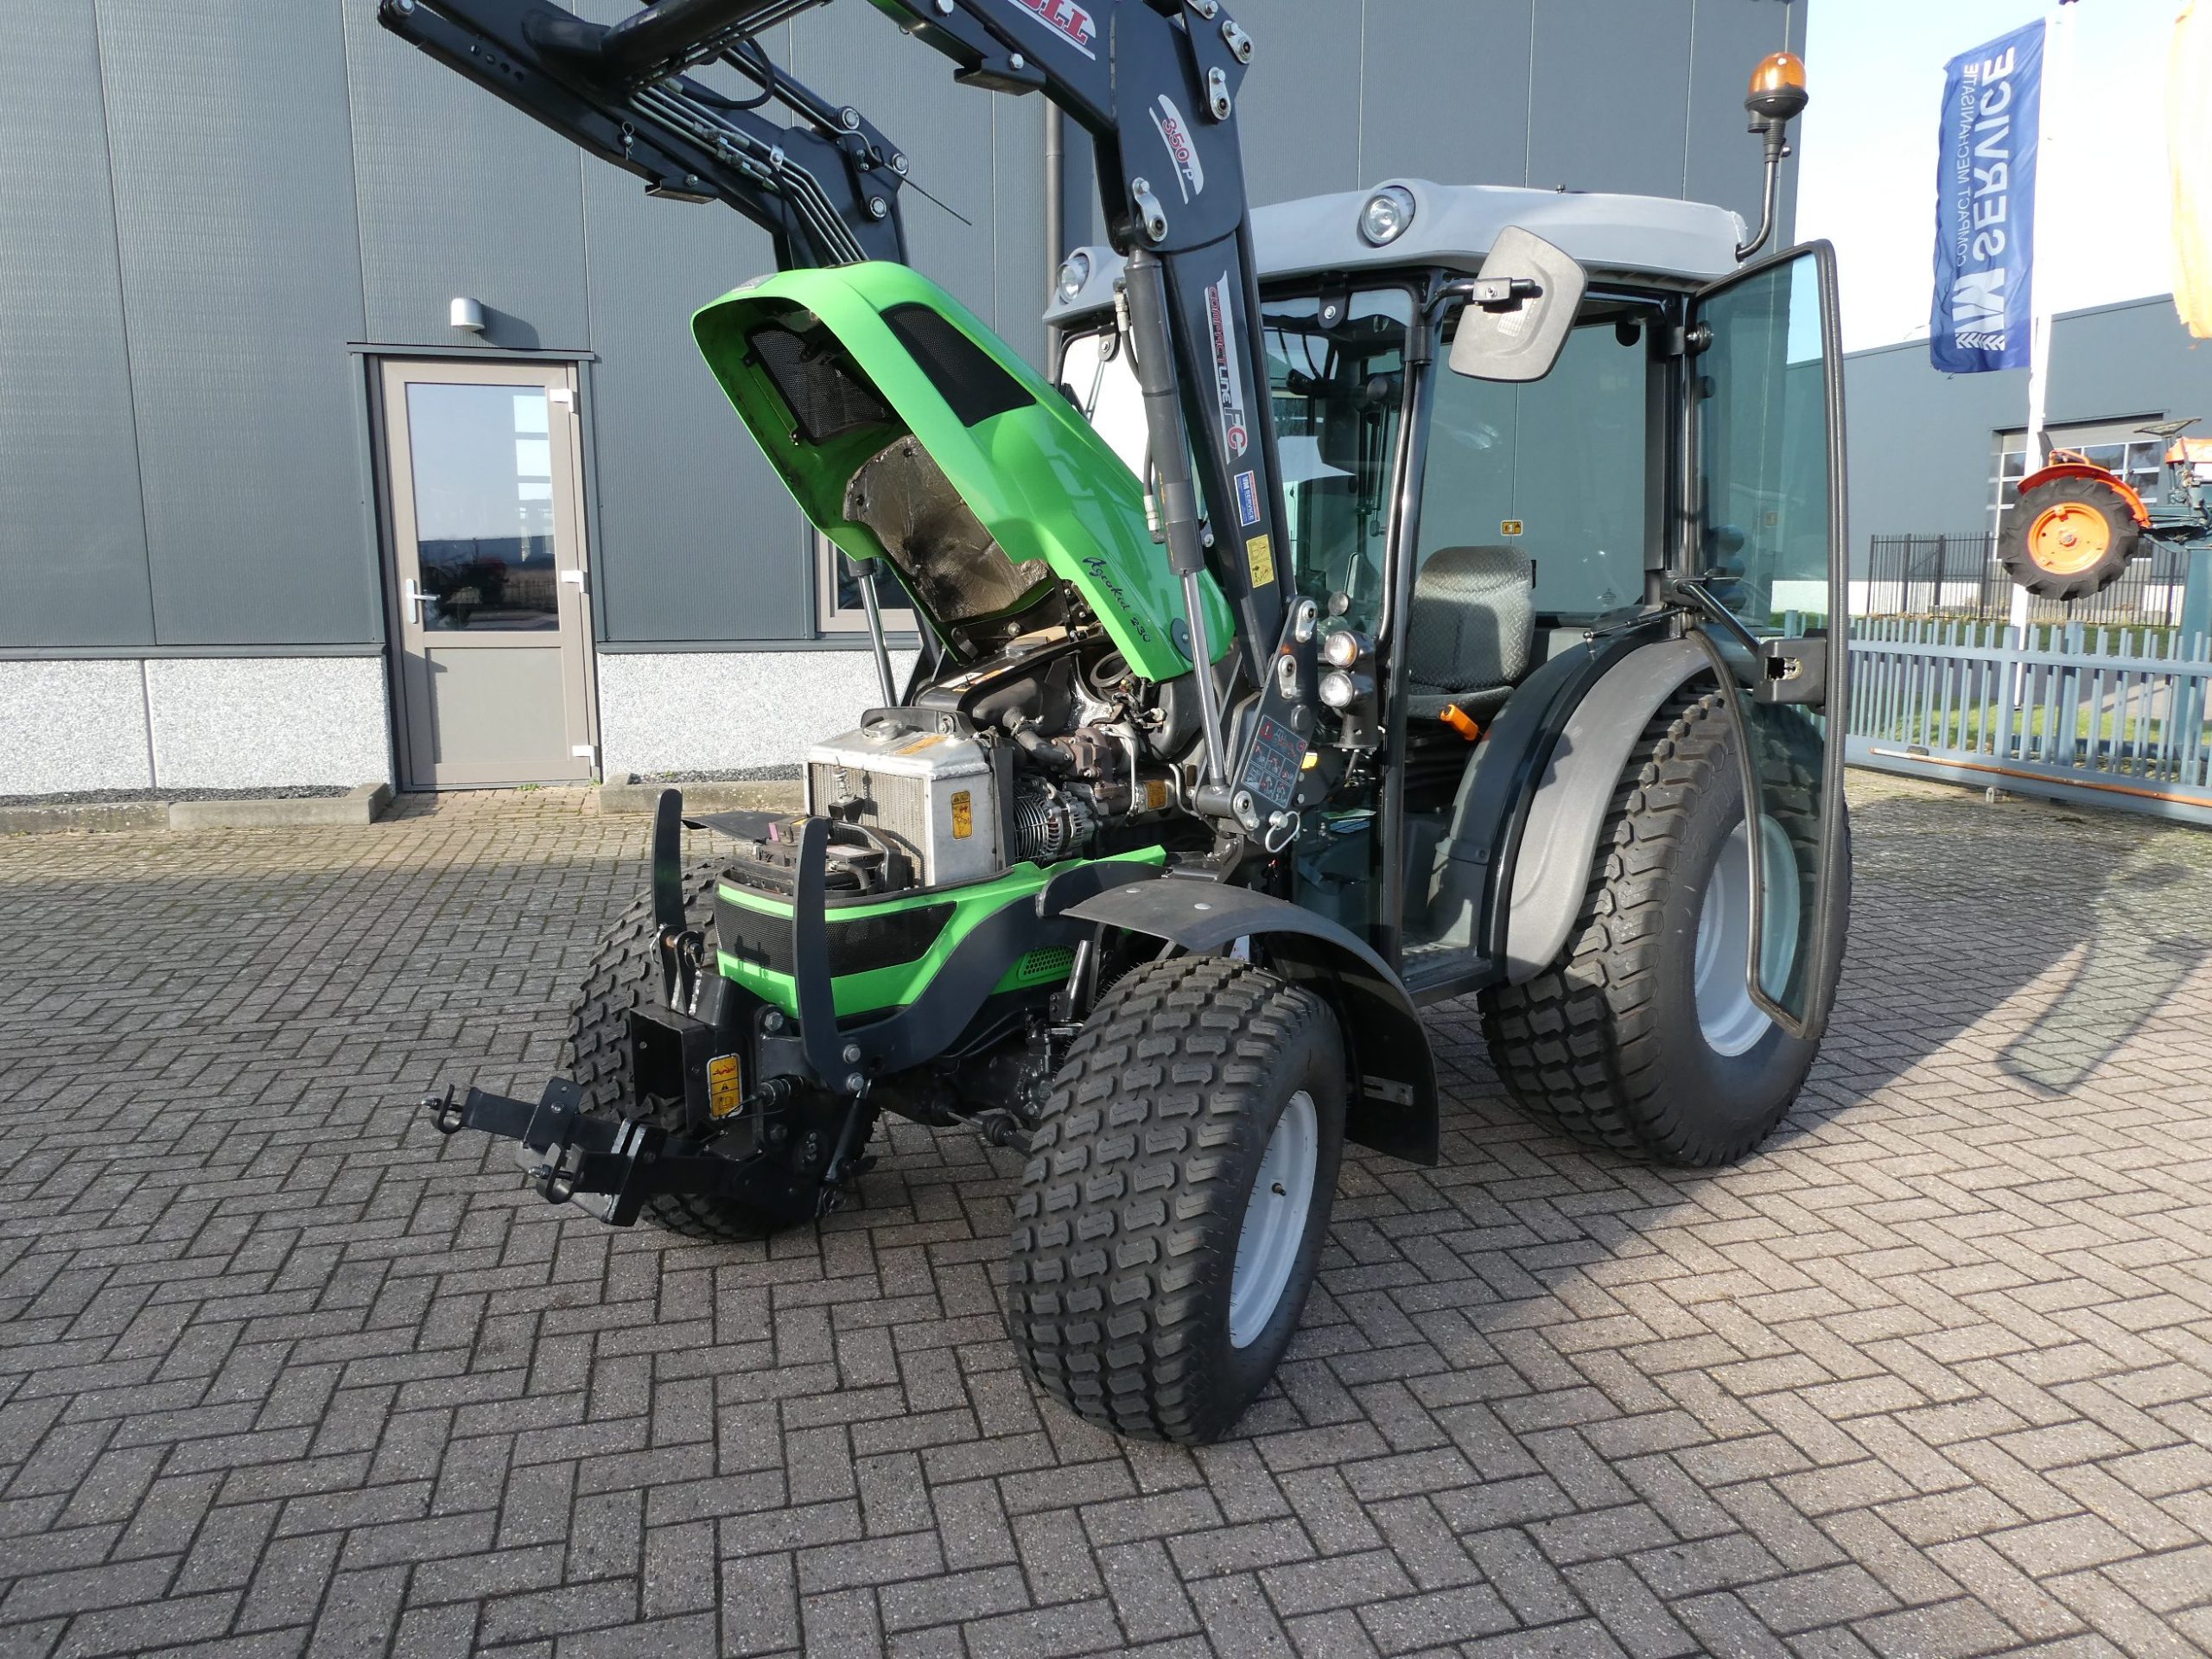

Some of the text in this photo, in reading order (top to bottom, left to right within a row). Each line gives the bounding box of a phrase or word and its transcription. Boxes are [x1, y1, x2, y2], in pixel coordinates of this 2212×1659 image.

[1161, 118, 1195, 181] 350 P
[1224, 409, 1248, 450] FC
[1242, 475, 1250, 490] VM
[1245, 489, 1255, 520] SERVICE
